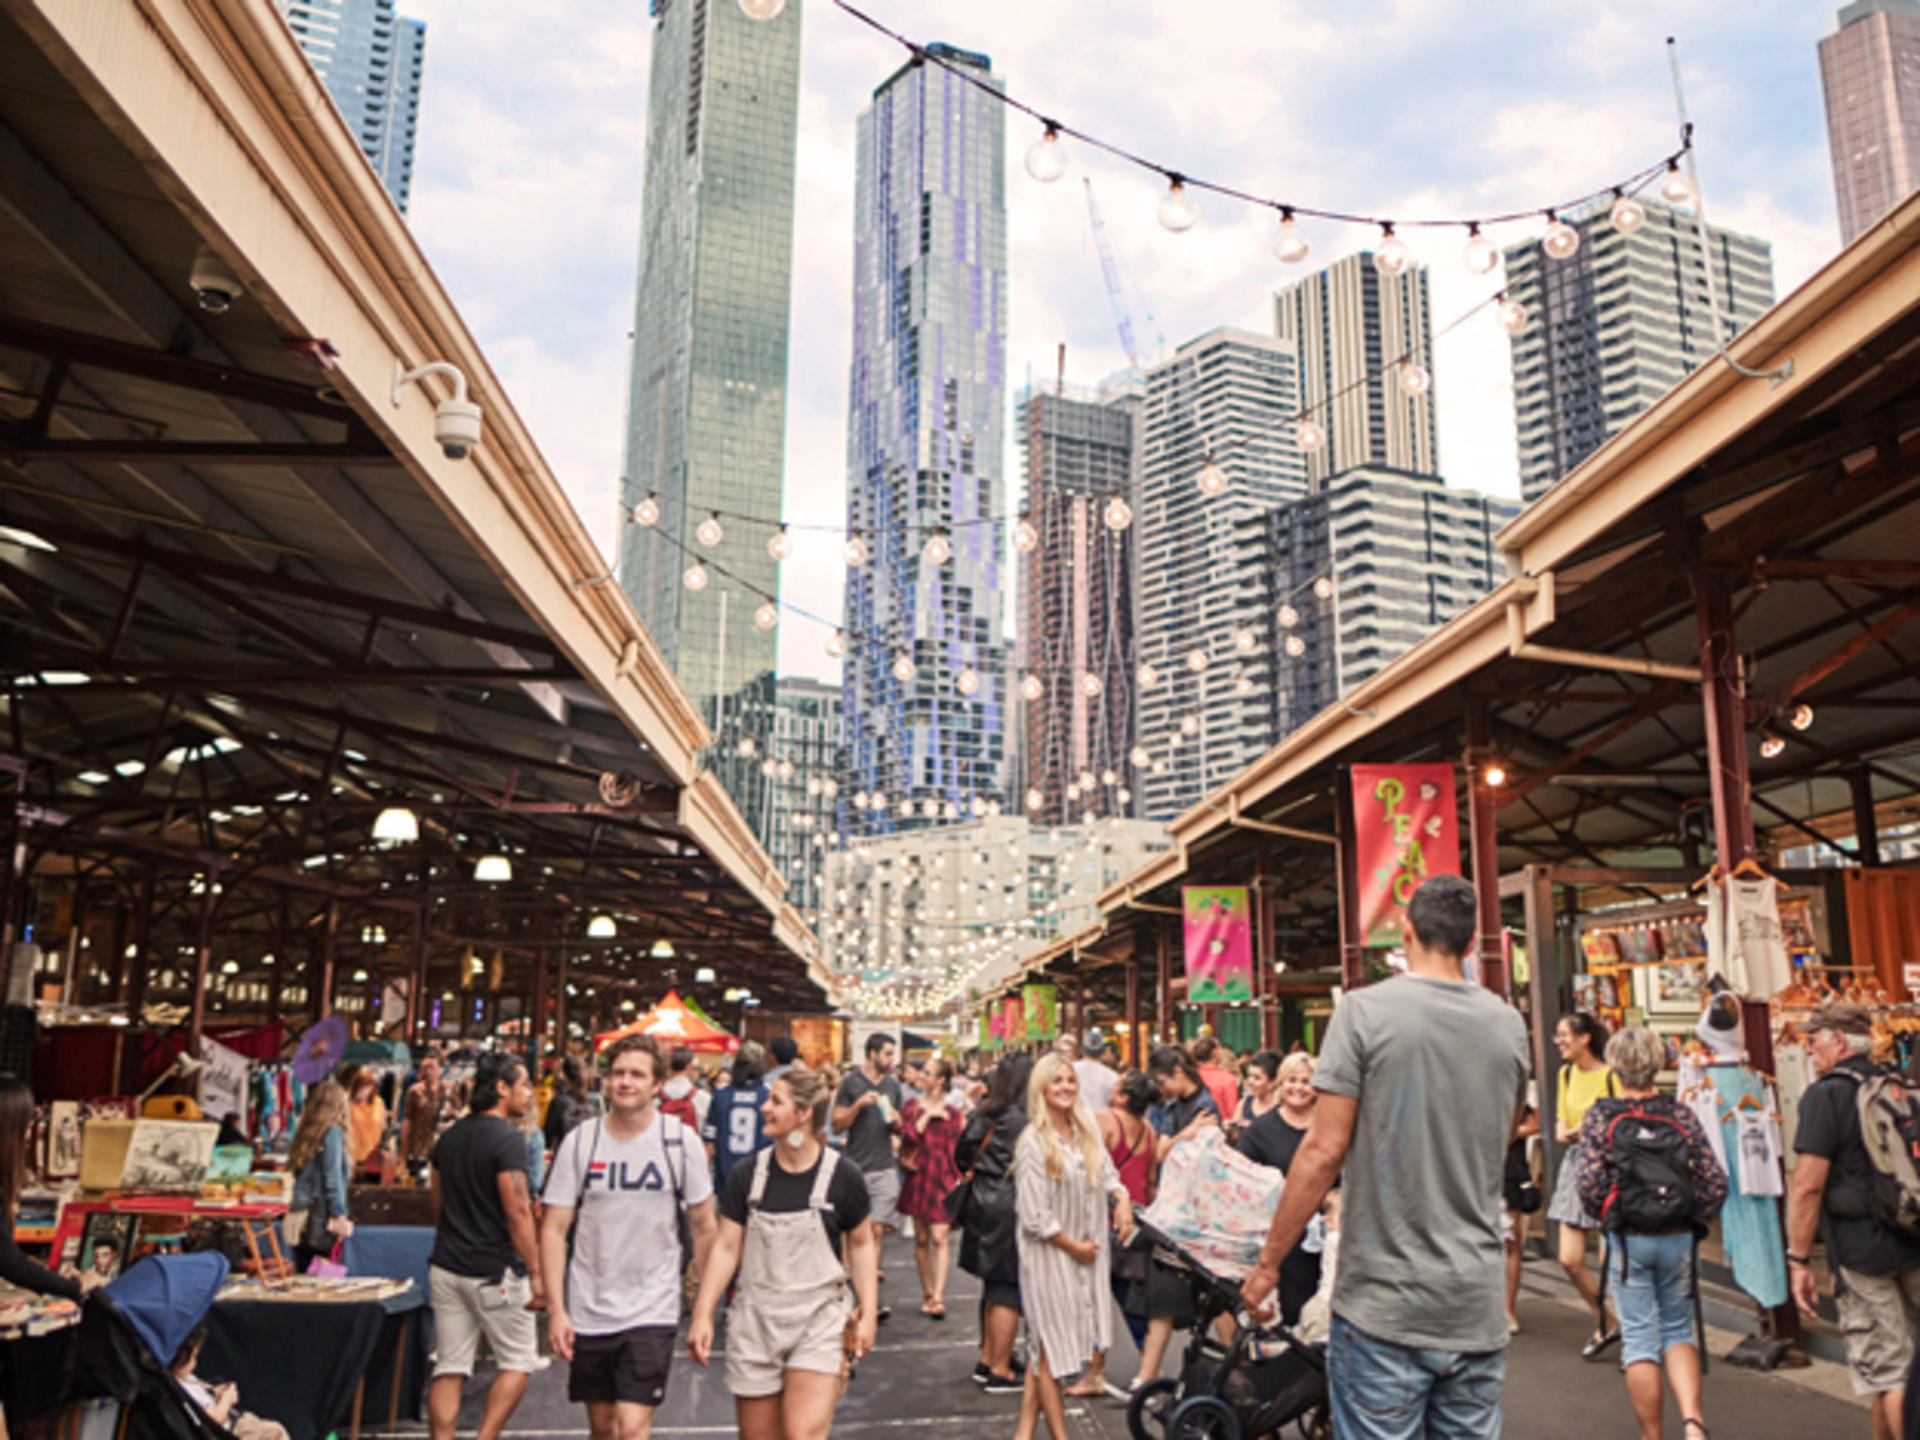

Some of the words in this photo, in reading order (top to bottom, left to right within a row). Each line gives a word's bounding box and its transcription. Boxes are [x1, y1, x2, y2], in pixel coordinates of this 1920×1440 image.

[1374, 778, 1427, 908] PEAC
[728, 1107, 758, 1154] 9
[584, 1160, 664, 1191] FILA
